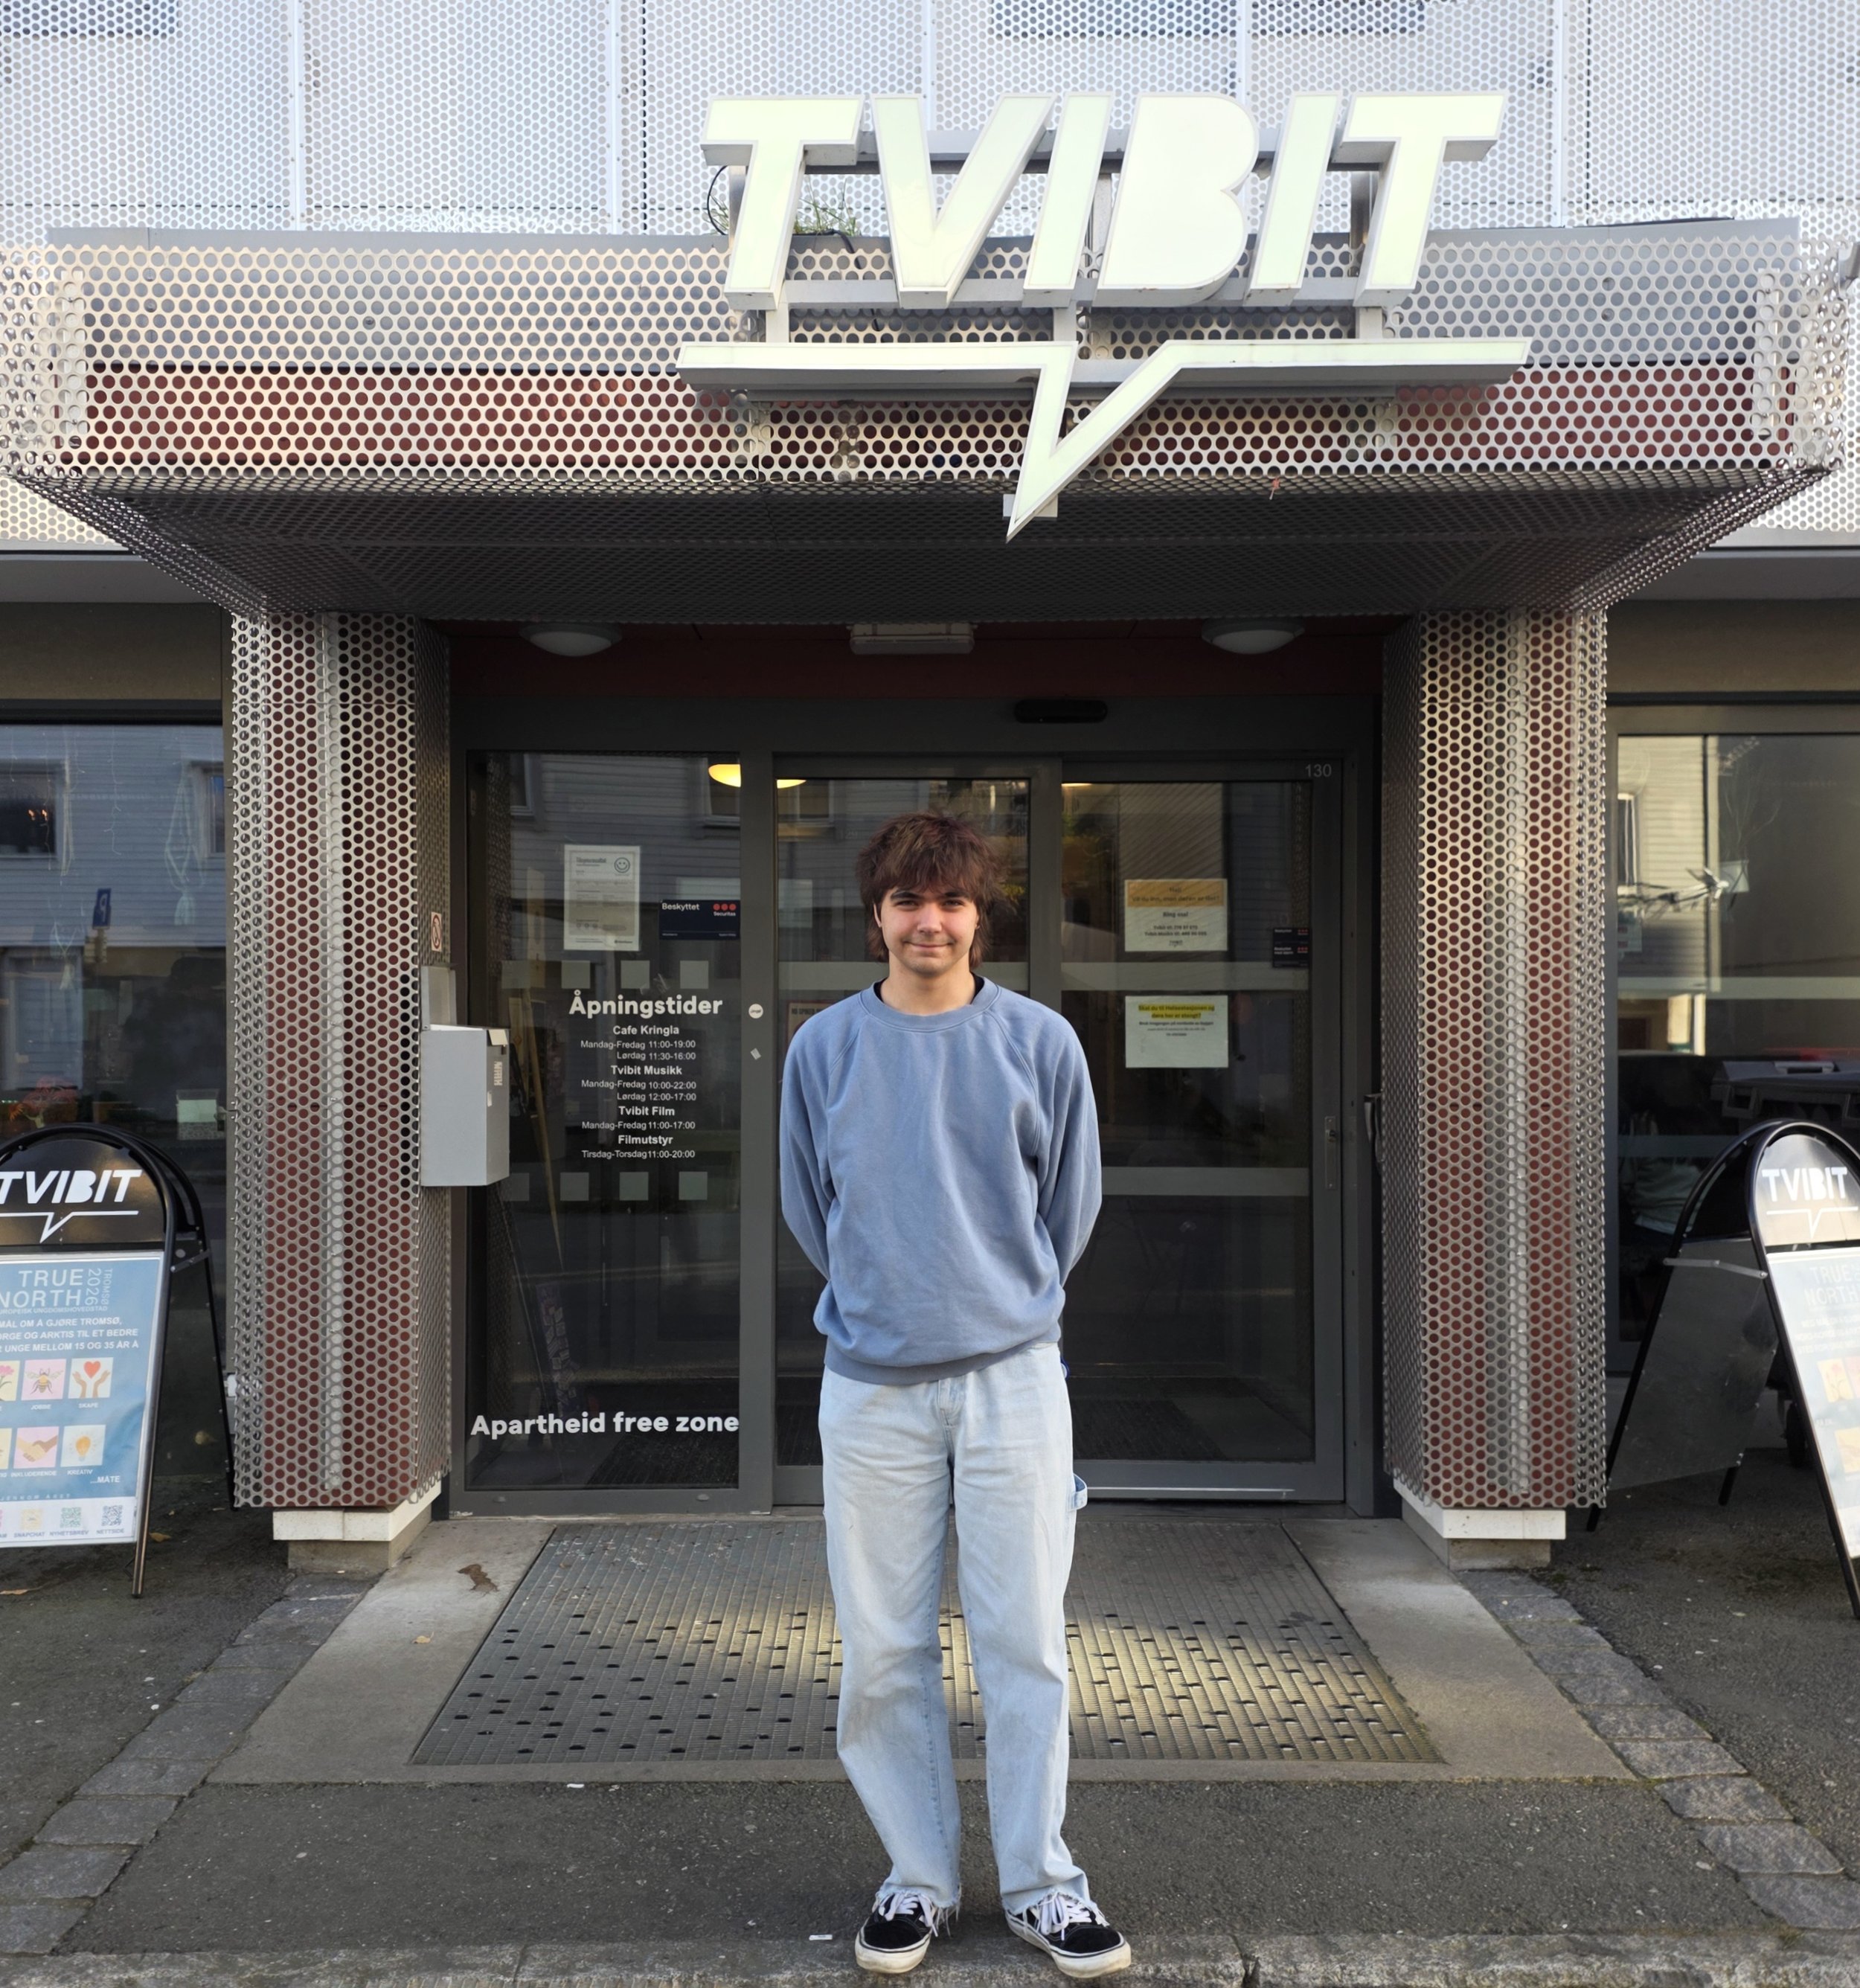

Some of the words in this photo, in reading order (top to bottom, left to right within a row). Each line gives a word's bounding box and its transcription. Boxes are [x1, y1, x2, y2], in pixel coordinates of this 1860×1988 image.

[702, 91, 1508, 307] TVIBIT
[1305, 763, 1333, 778] 130
[661, 902, 700, 911] Beskyttet
[568, 990, 723, 1019] Åpningstider
[612, 1025, 638, 1035] Cafe
[640, 1025, 679, 1036] Kringla
[580, 1040, 646, 1050] Mandag-Fredag
[648, 1040, 696, 1048] 11:00-19:00
[617, 1051, 646, 1060] Lørdag
[648, 1052, 696, 1060] 11:30-16:00
[610, 1065, 641, 1075] Tvibit
[644, 1065, 682, 1075] Musikk
[581, 1080, 647, 1090] Mandag-Fredag
[648, 1081, 696, 1089] 10:00-22:00
[617, 1092, 646, 1101] Lørdag
[648, 1093, 696, 1101] 12:00-17:00
[618, 1106, 649, 1116] Tvibit
[651, 1106, 675, 1116] Film
[581, 1121, 647, 1130] Mandag-Fredag
[648, 1121, 696, 1129] 11:00-17:00
[618, 1135, 673, 1147] Filmutstyr
[581, 1149, 647, 1159] Tirsdag-Torsdag
[647, 1149, 696, 1158] 11:00-20:00
[0, 1169, 142, 1205] TVIBIT
[1761, 1167, 1847, 1202] TVIBIT
[18, 1269, 84, 1287] TRUE
[84, 1268, 102, 1306] 2026
[19, 1319, 34, 1328] OM
[46, 1318, 78, 1327] GJØRE
[24, 1331, 38, 1339] OG
[39, 1330, 74, 1338] ARKTIS
[77, 1330, 90, 1338] TIL
[92, 1329, 105, 1337] ET
[106, 1328, 139, 1337] BEDRE
[4, 1344, 31, 1353] UNGE
[33, 1342, 72, 1352] MELLOM
[87, 1341, 102, 1350] OG
[104, 1341, 115, 1349] 35
[470, 1411, 606, 1440] Apartheid
[612, 1411, 670, 1433] free
[676, 1416, 739, 1432] zone
